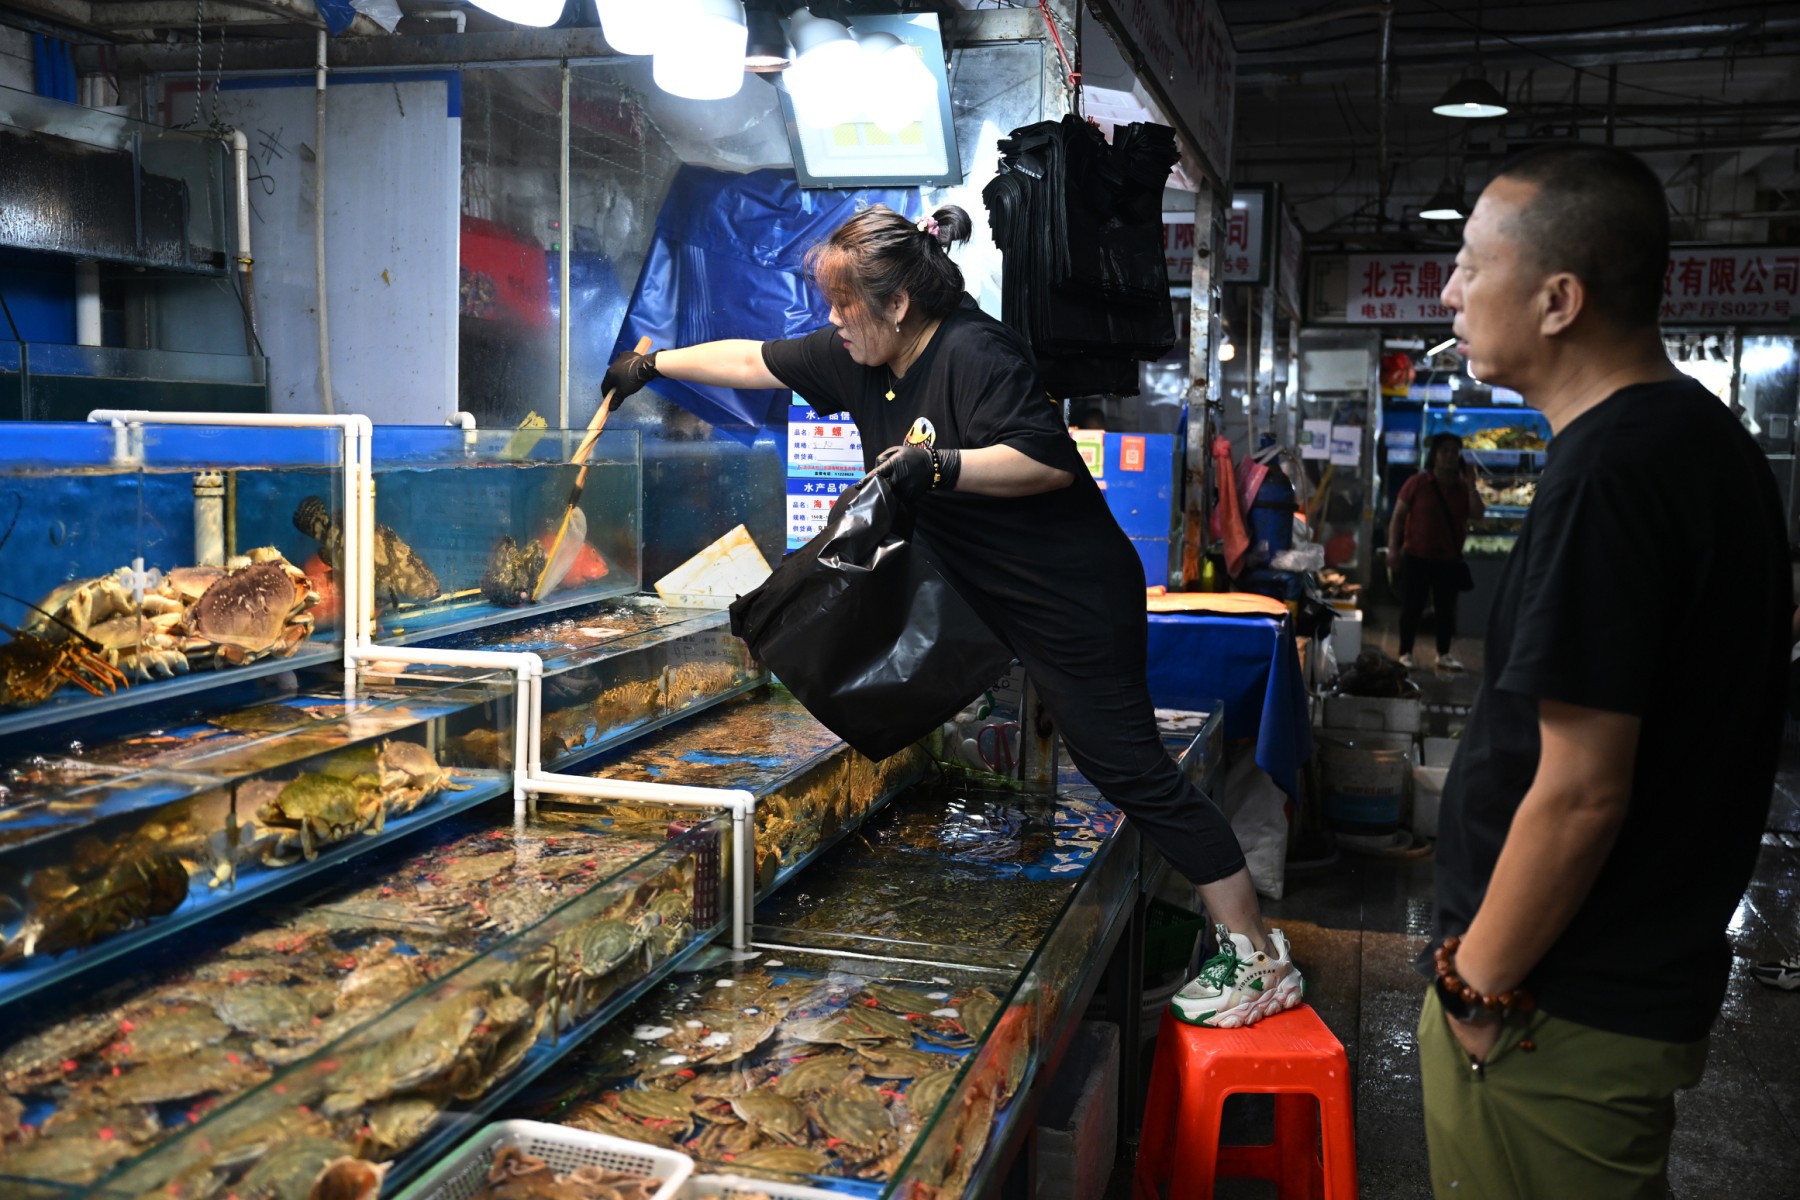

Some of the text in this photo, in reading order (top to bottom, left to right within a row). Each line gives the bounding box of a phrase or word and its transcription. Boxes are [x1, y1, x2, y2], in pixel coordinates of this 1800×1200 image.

[1361, 260, 1457, 299] 北京鼎
[805, 410, 850, 420] 水品信
[814, 426, 842, 436] 海螺
